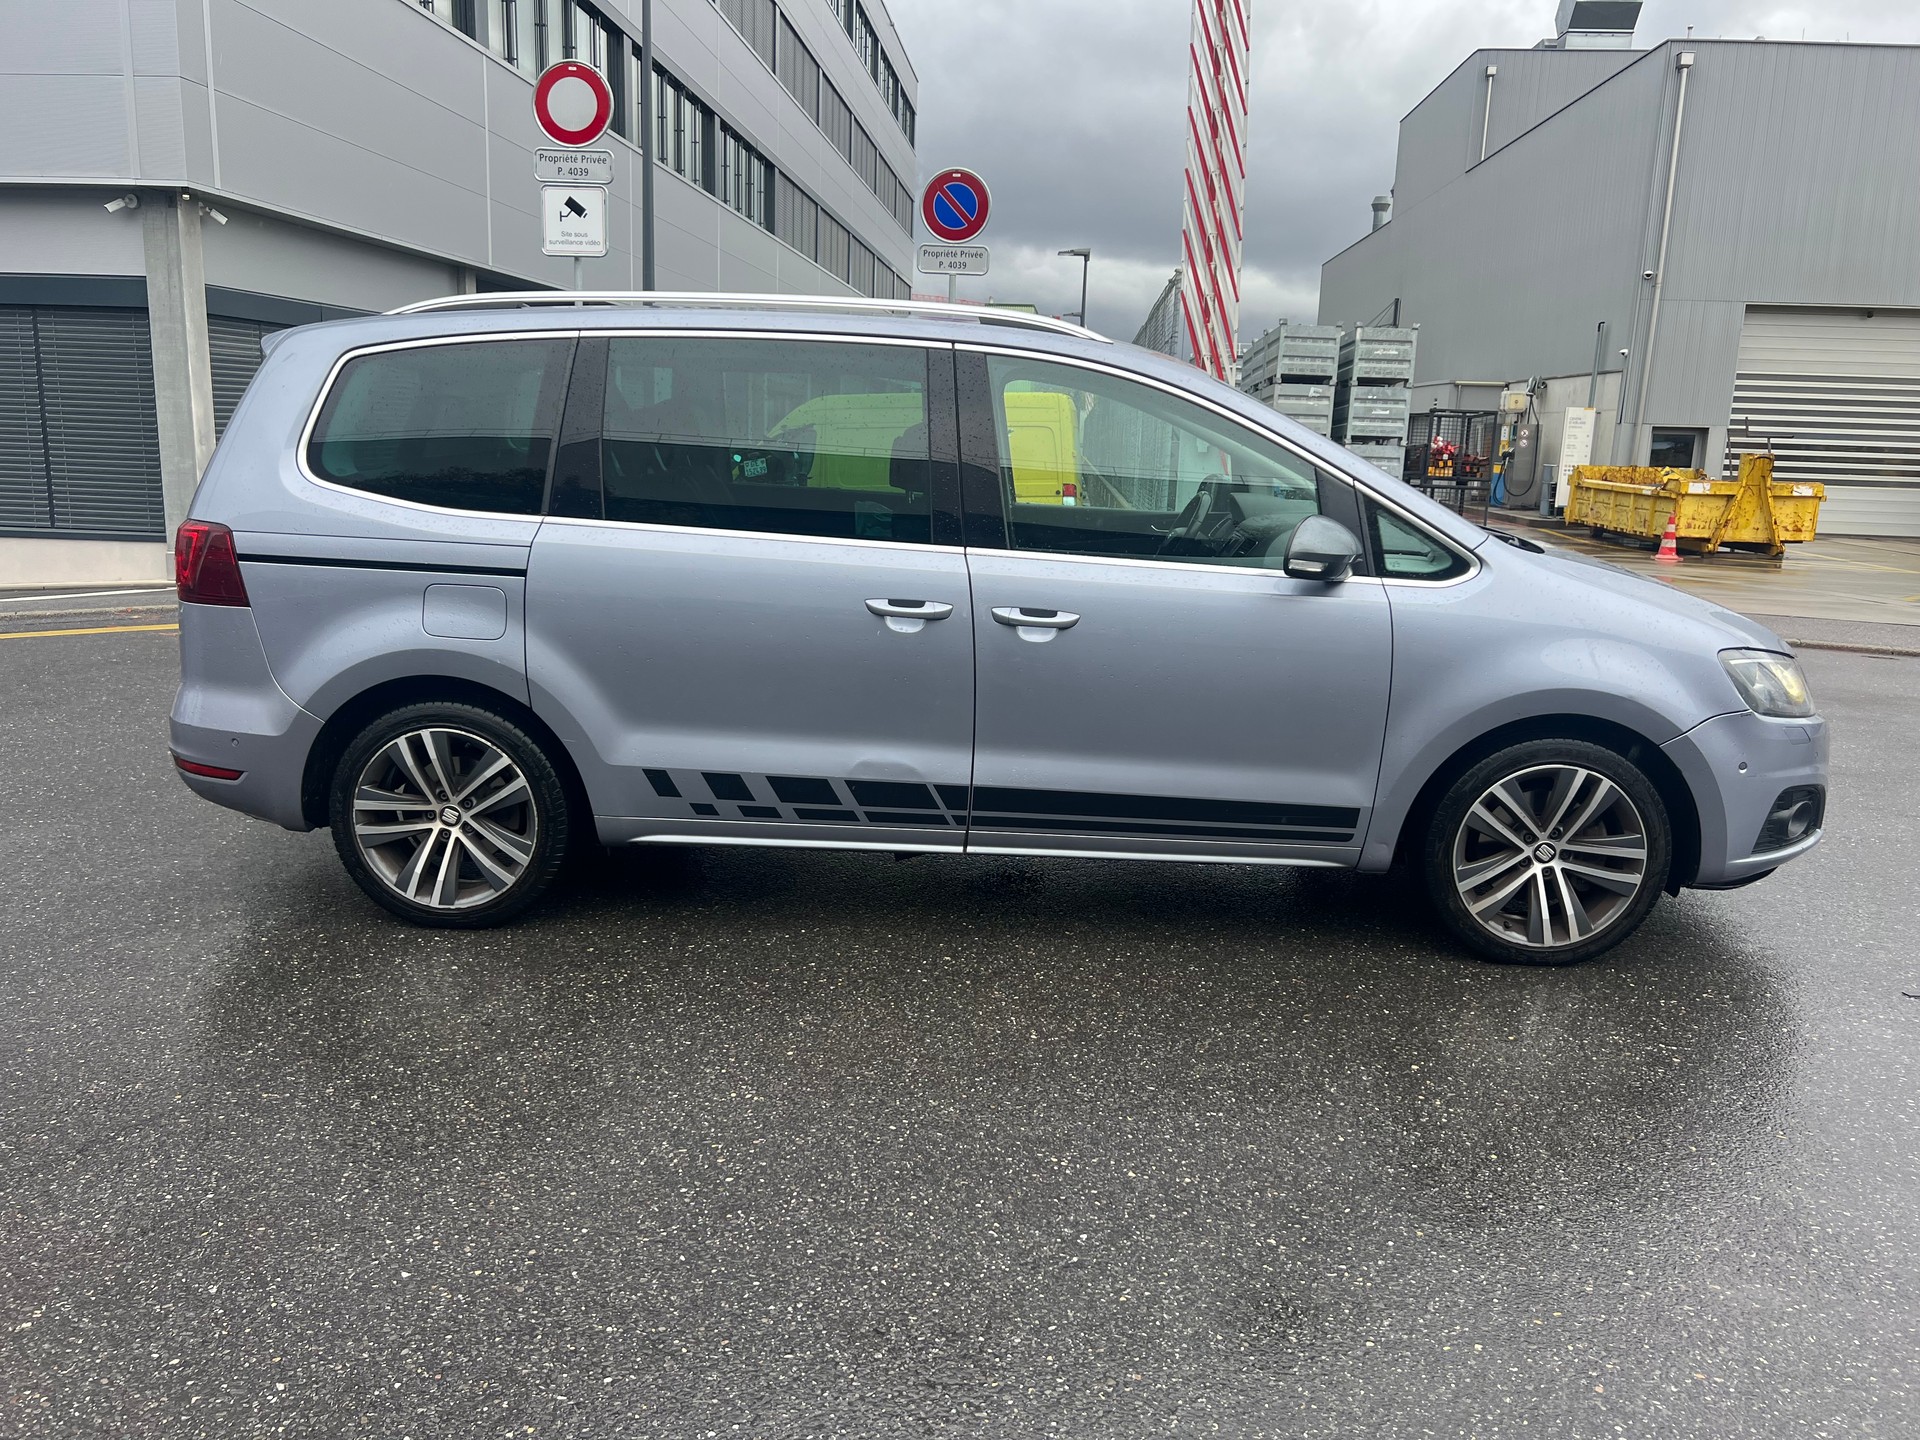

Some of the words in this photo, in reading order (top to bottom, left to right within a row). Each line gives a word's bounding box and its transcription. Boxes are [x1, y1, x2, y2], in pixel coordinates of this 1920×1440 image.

[539, 153, 578, 164] Propriété
[581, 155, 607, 164] Privée
[557, 167, 565, 176] P.
[568, 168, 589, 176] 4039
[923, 249, 958, 259] Propriété
[960, 250, 983, 259] Privée
[938, 261, 946, 269] P.
[948, 261, 967, 270] 4039
